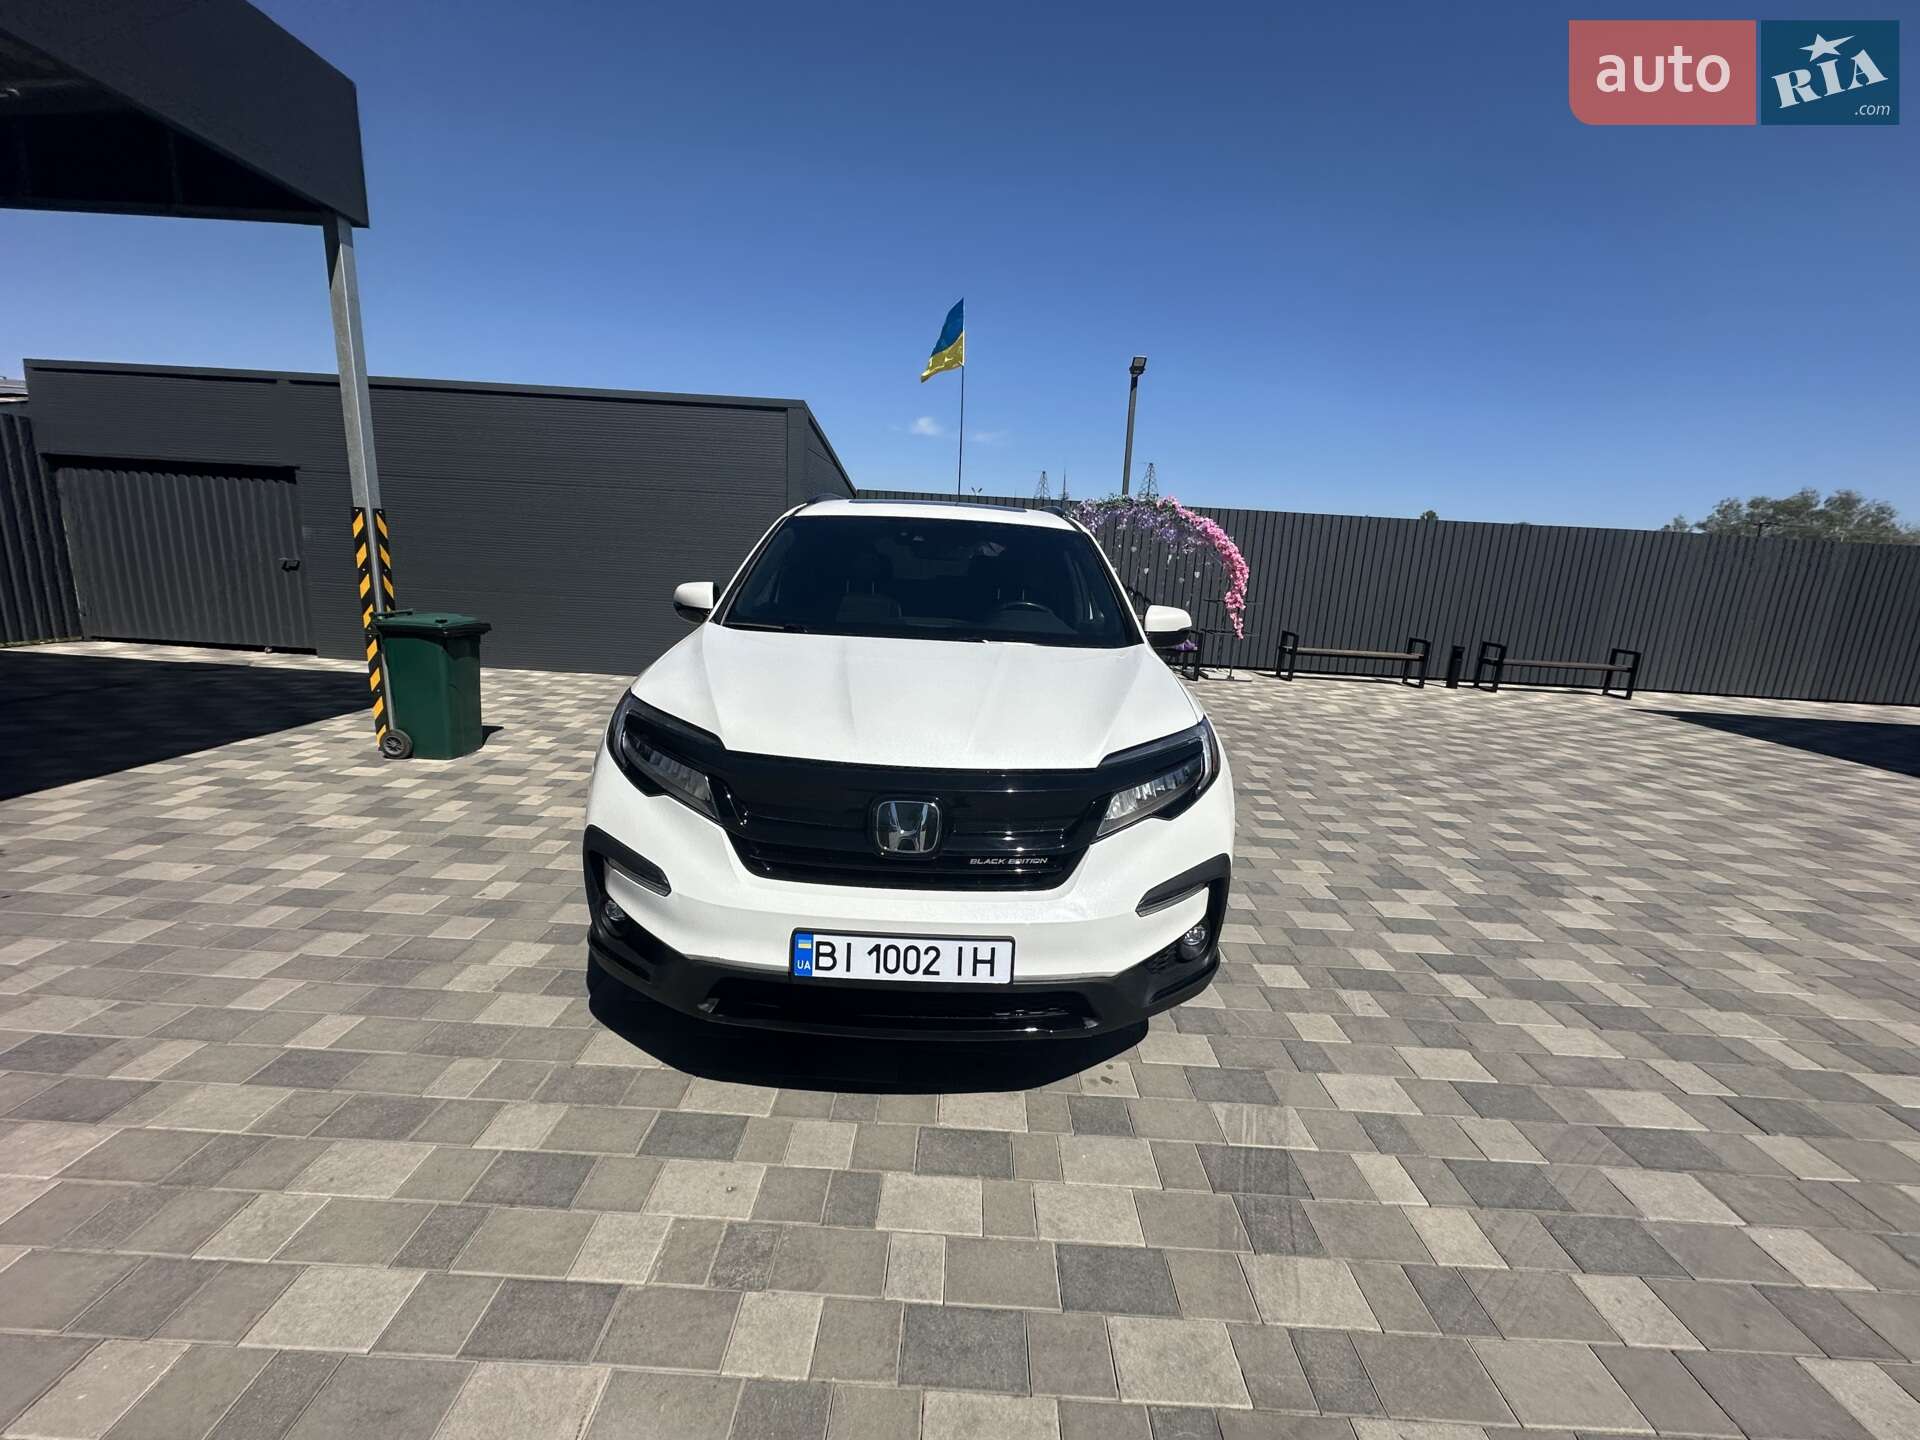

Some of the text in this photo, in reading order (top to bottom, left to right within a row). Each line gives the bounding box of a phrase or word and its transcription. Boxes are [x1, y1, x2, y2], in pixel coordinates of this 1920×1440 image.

[797, 960, 811, 970] UA
[814, 941, 996, 977] BI 1002 IH
